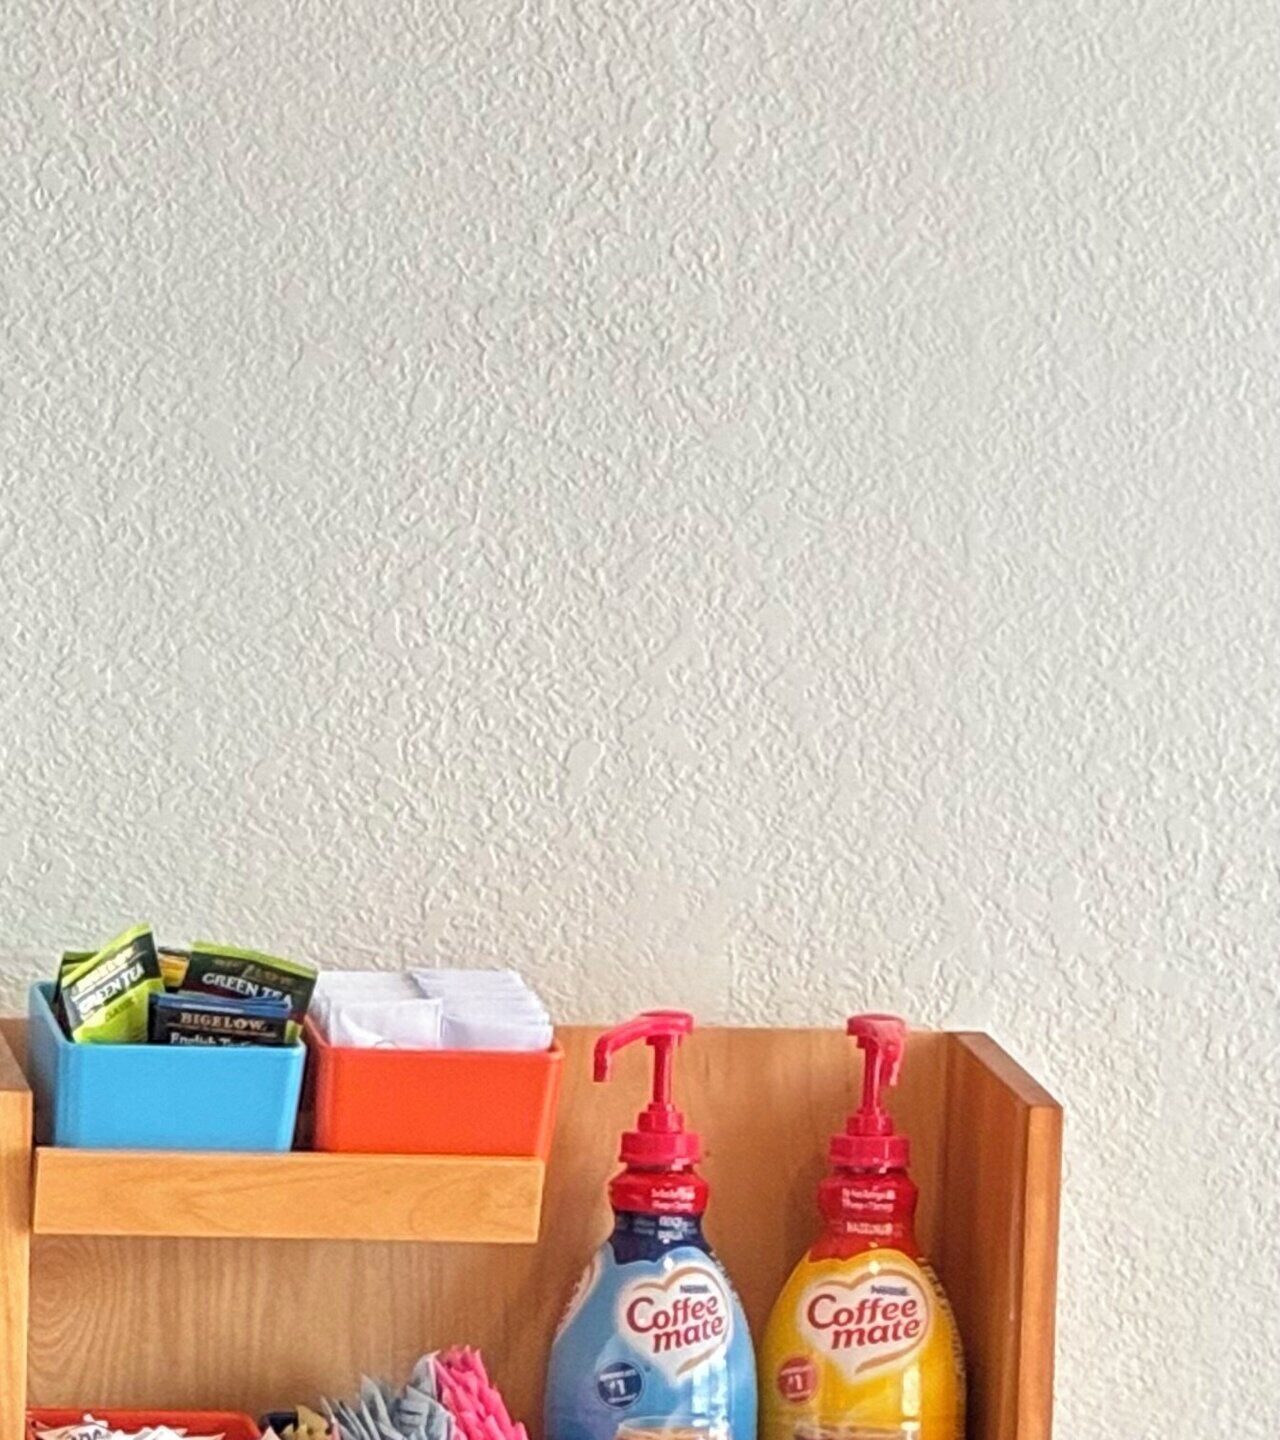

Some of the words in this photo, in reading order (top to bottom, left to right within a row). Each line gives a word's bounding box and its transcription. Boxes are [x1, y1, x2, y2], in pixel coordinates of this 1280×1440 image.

[202, 972, 259, 997] GREEN
[626, 1296, 719, 1333] Coffee
[808, 1294, 918, 1330] Coffee
[653, 1316, 724, 1353] mate
[831, 1319, 920, 1350] mate
